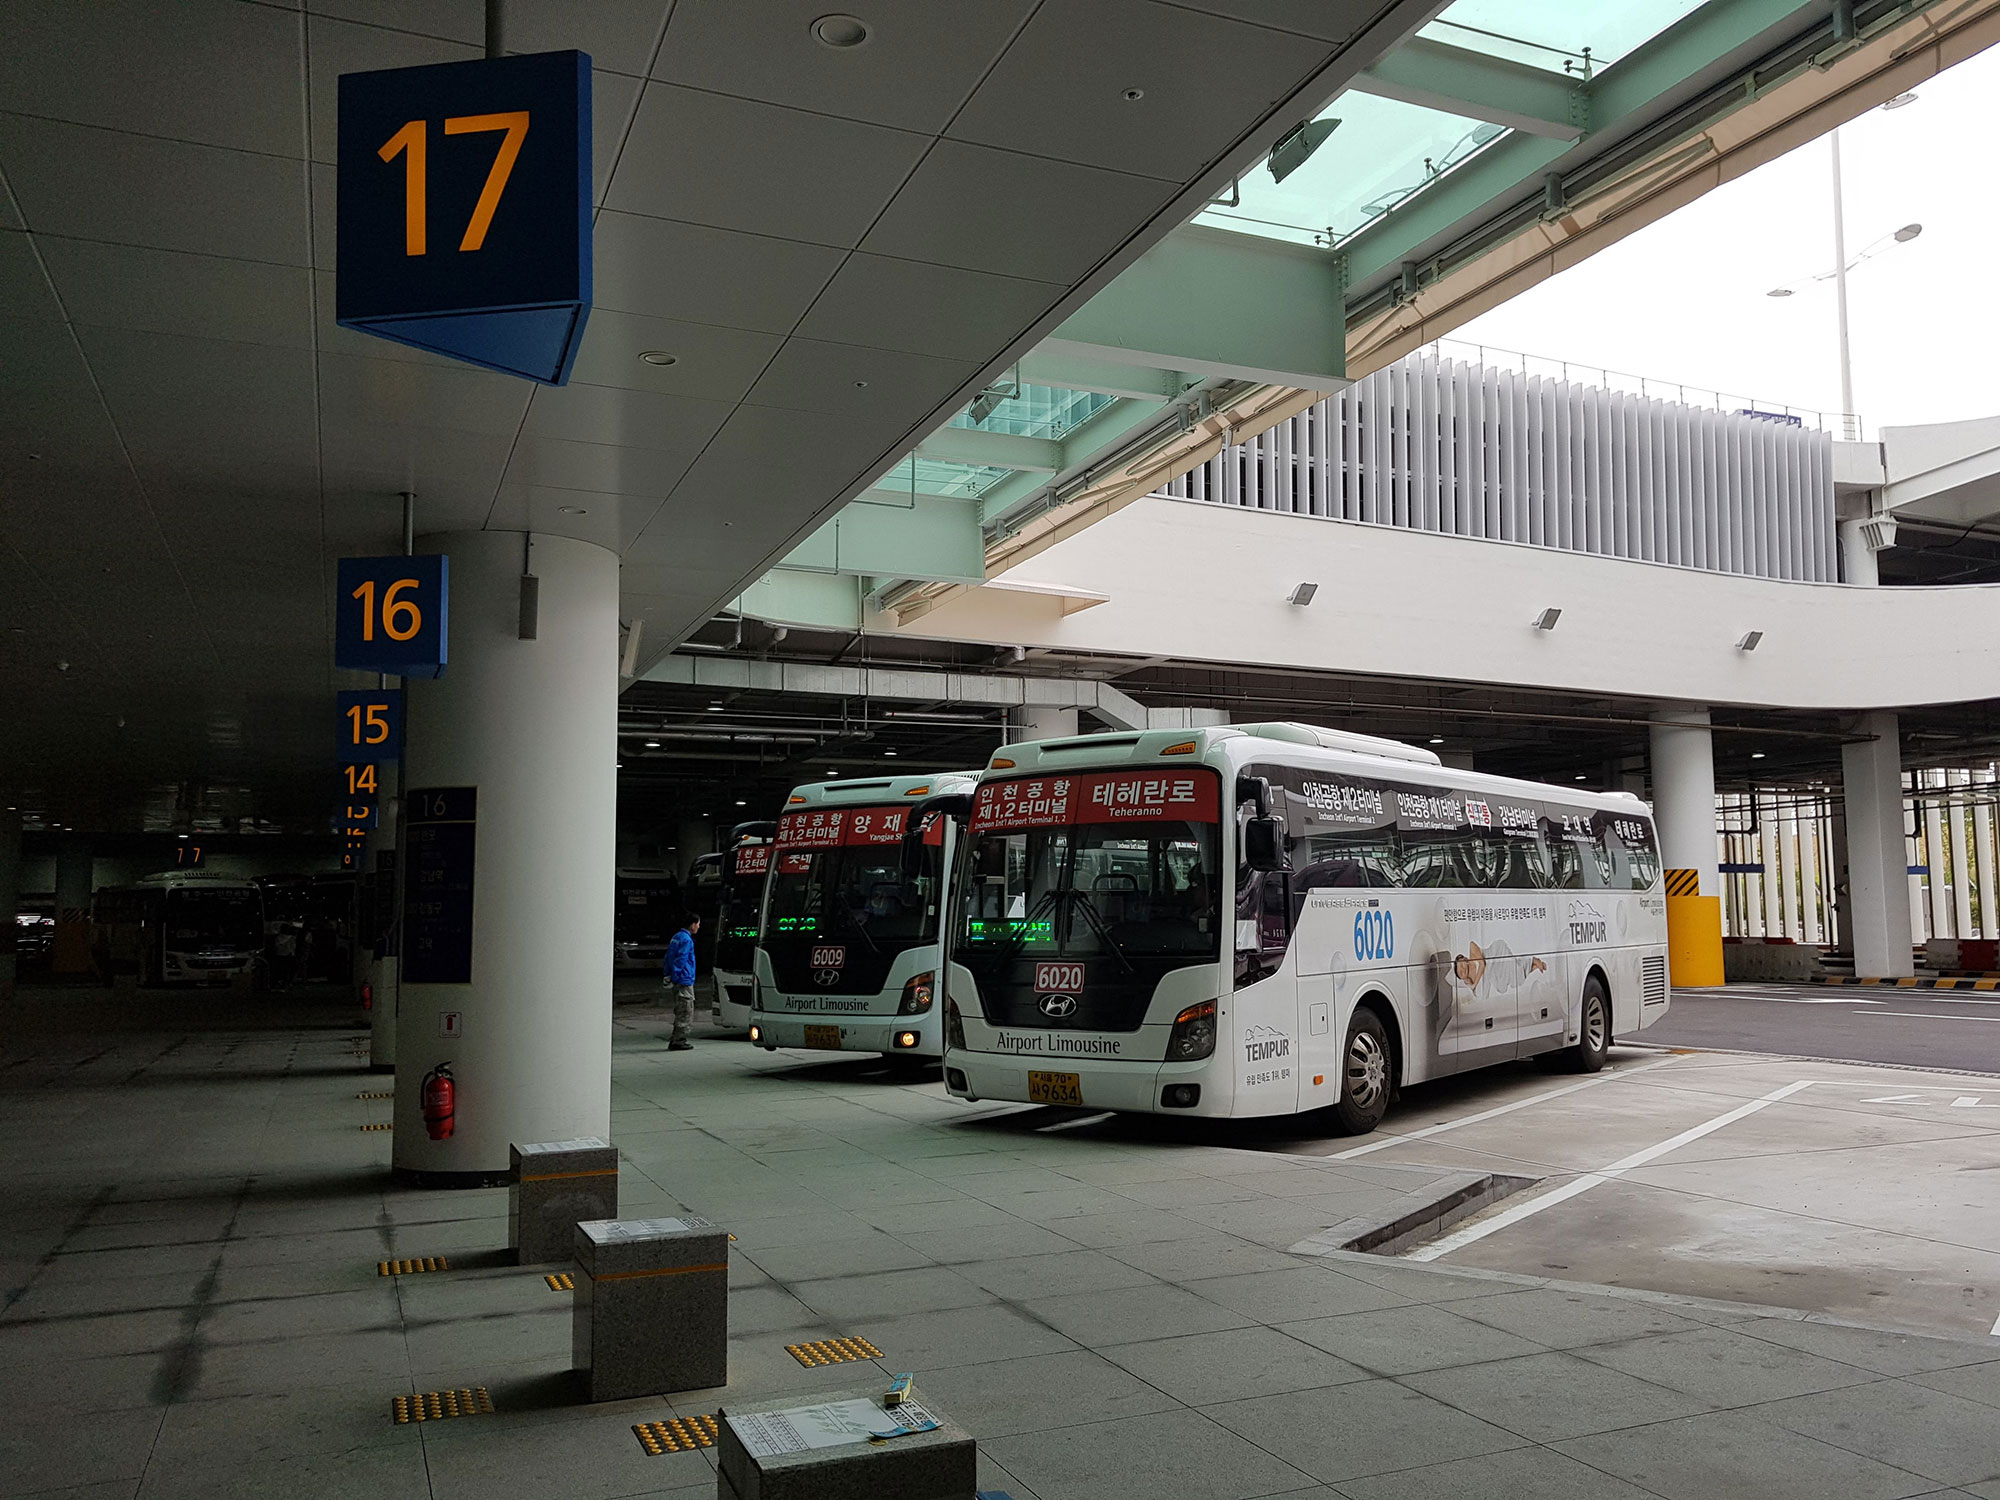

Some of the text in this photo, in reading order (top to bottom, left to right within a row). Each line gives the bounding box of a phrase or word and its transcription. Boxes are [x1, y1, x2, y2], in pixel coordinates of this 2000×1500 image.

[378, 111, 529, 256] 17
[352, 579, 421, 641] 16
[346, 704, 389, 745] 15
[344, 764, 377, 795] 14
[1092, 780, 1196, 806] 테헤란로
[1007, 817, 1027, 826] Airport
[1028, 815, 1053, 824] Terminal
[1109, 806, 1162, 816] Teheranno
[1499, 806, 1538, 829] 강남터미널
[869, 833, 894, 842] Yangjae
[1614, 820, 1645, 839] 테헤란로
[1354, 910, 1394, 961] 6020
[1569, 922, 1607, 944] TEMPUR
[813, 949, 843, 965] 6009
[1039, 967, 1081, 989] 6020
[785, 997, 869, 1011] Airport Limousine
[997, 1032, 1120, 1054] Airport Limousine
[1245, 1039, 1289, 1062] TEMPUR
[1054, 1074, 1066, 1083] 70
